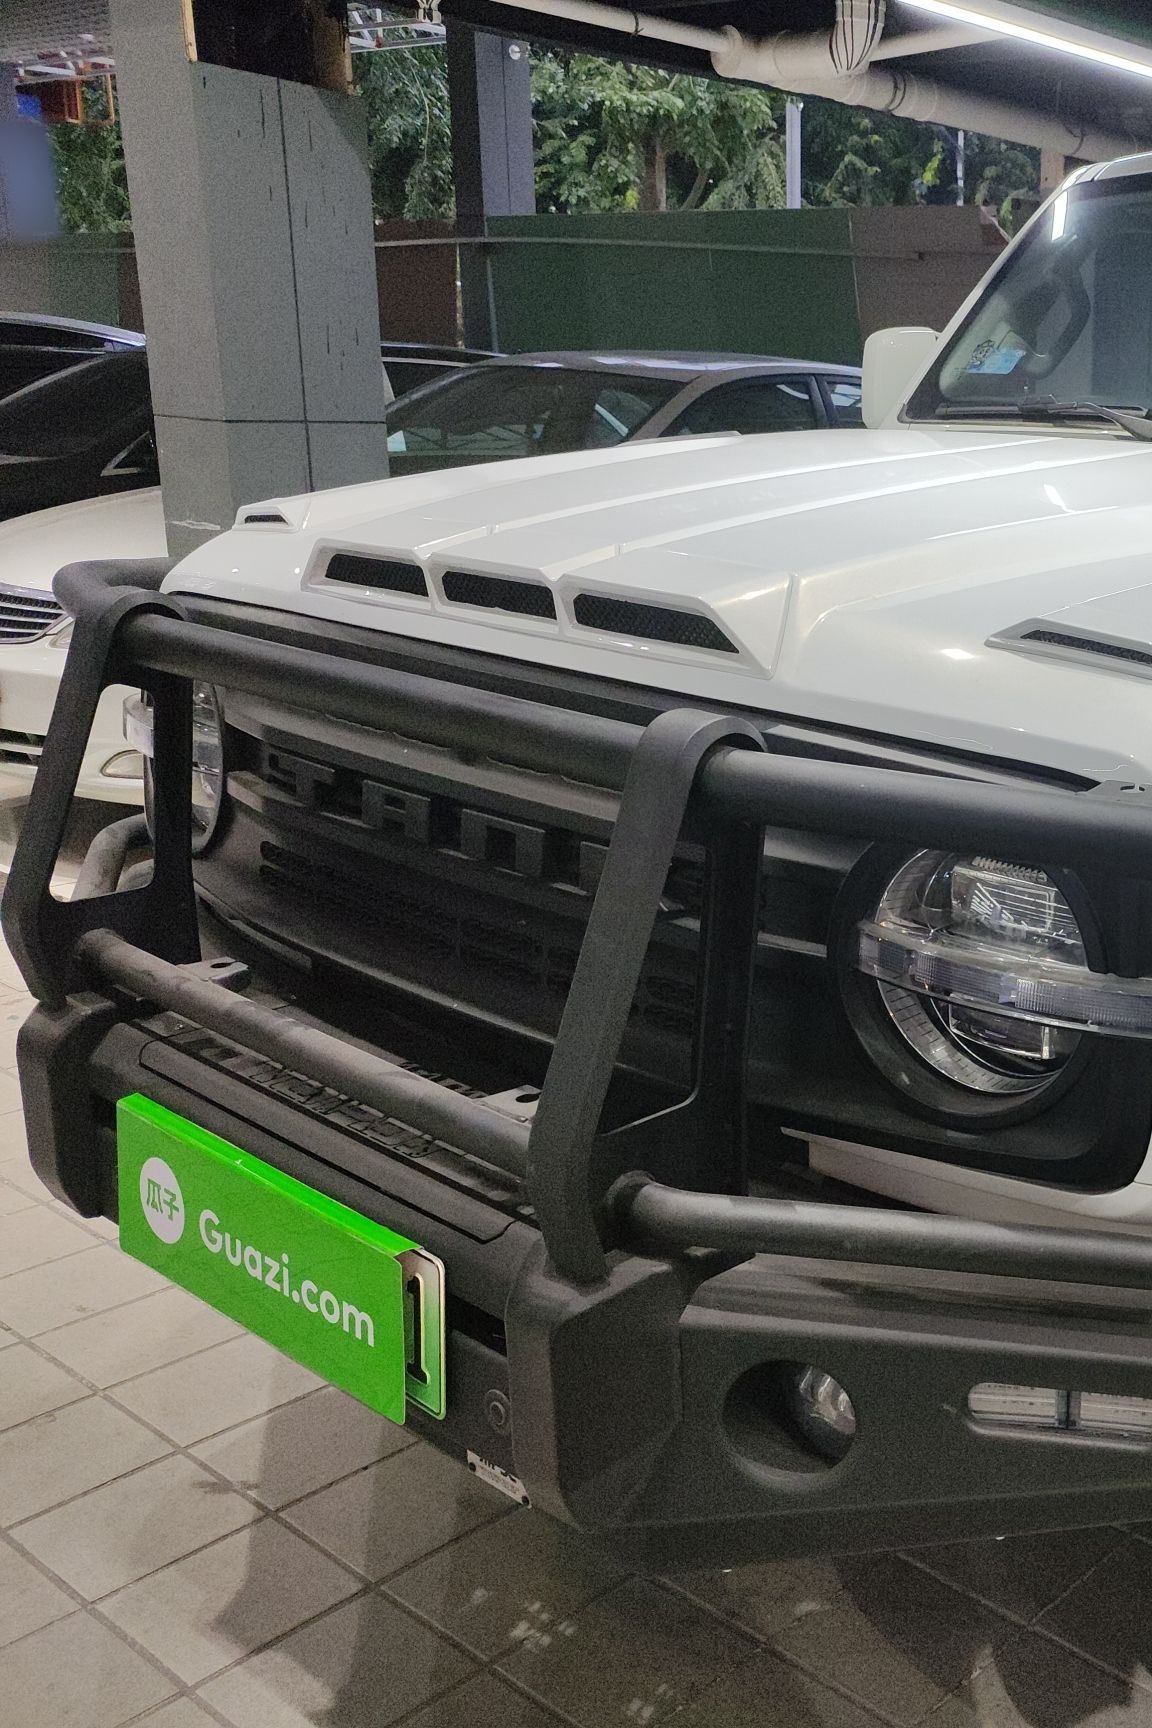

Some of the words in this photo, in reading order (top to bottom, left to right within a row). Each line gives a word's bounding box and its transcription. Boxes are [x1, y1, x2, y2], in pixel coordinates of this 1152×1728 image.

[275, 749, 665, 906] TAN
[146, 1179, 180, 1222] 瓜子
[199, 1208, 375, 1347] Guazi.com
